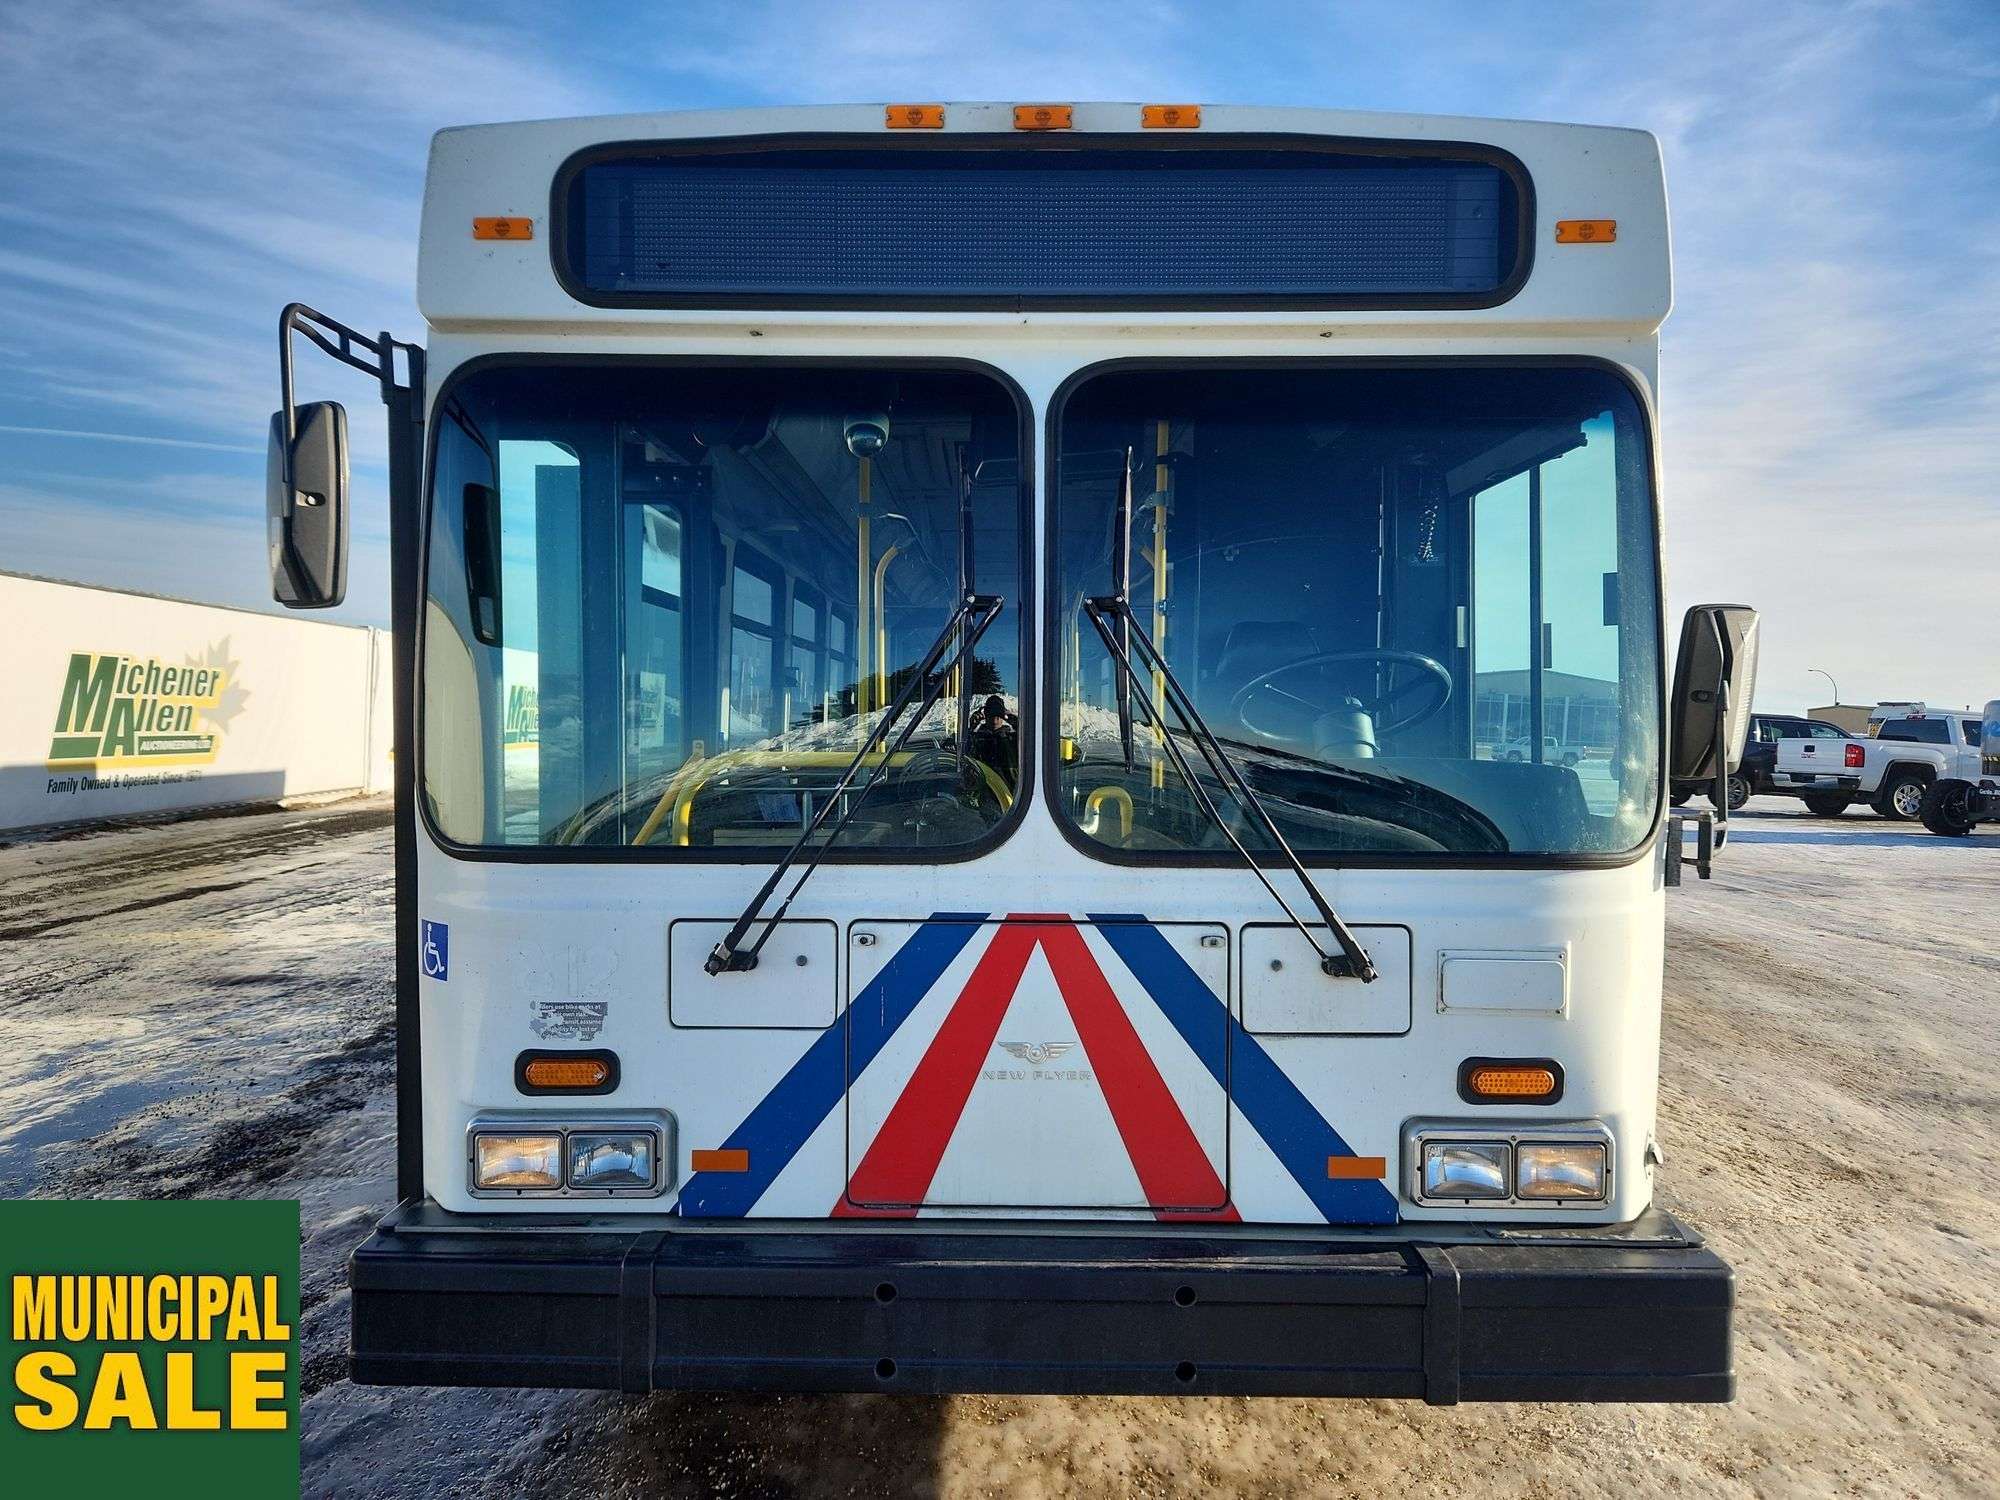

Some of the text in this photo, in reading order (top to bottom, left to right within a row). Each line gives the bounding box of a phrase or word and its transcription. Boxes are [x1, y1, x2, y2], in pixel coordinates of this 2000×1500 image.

[55, 654, 221, 732] Michener
[102, 698, 193, 756] Allen
[47, 778, 78, 794] Family
[80, 776, 111, 791] Owned
[113, 777, 120, 788] &
[123, 774, 159, 789] Operated
[983, 1070, 1093, 1081] NEW FLYER
